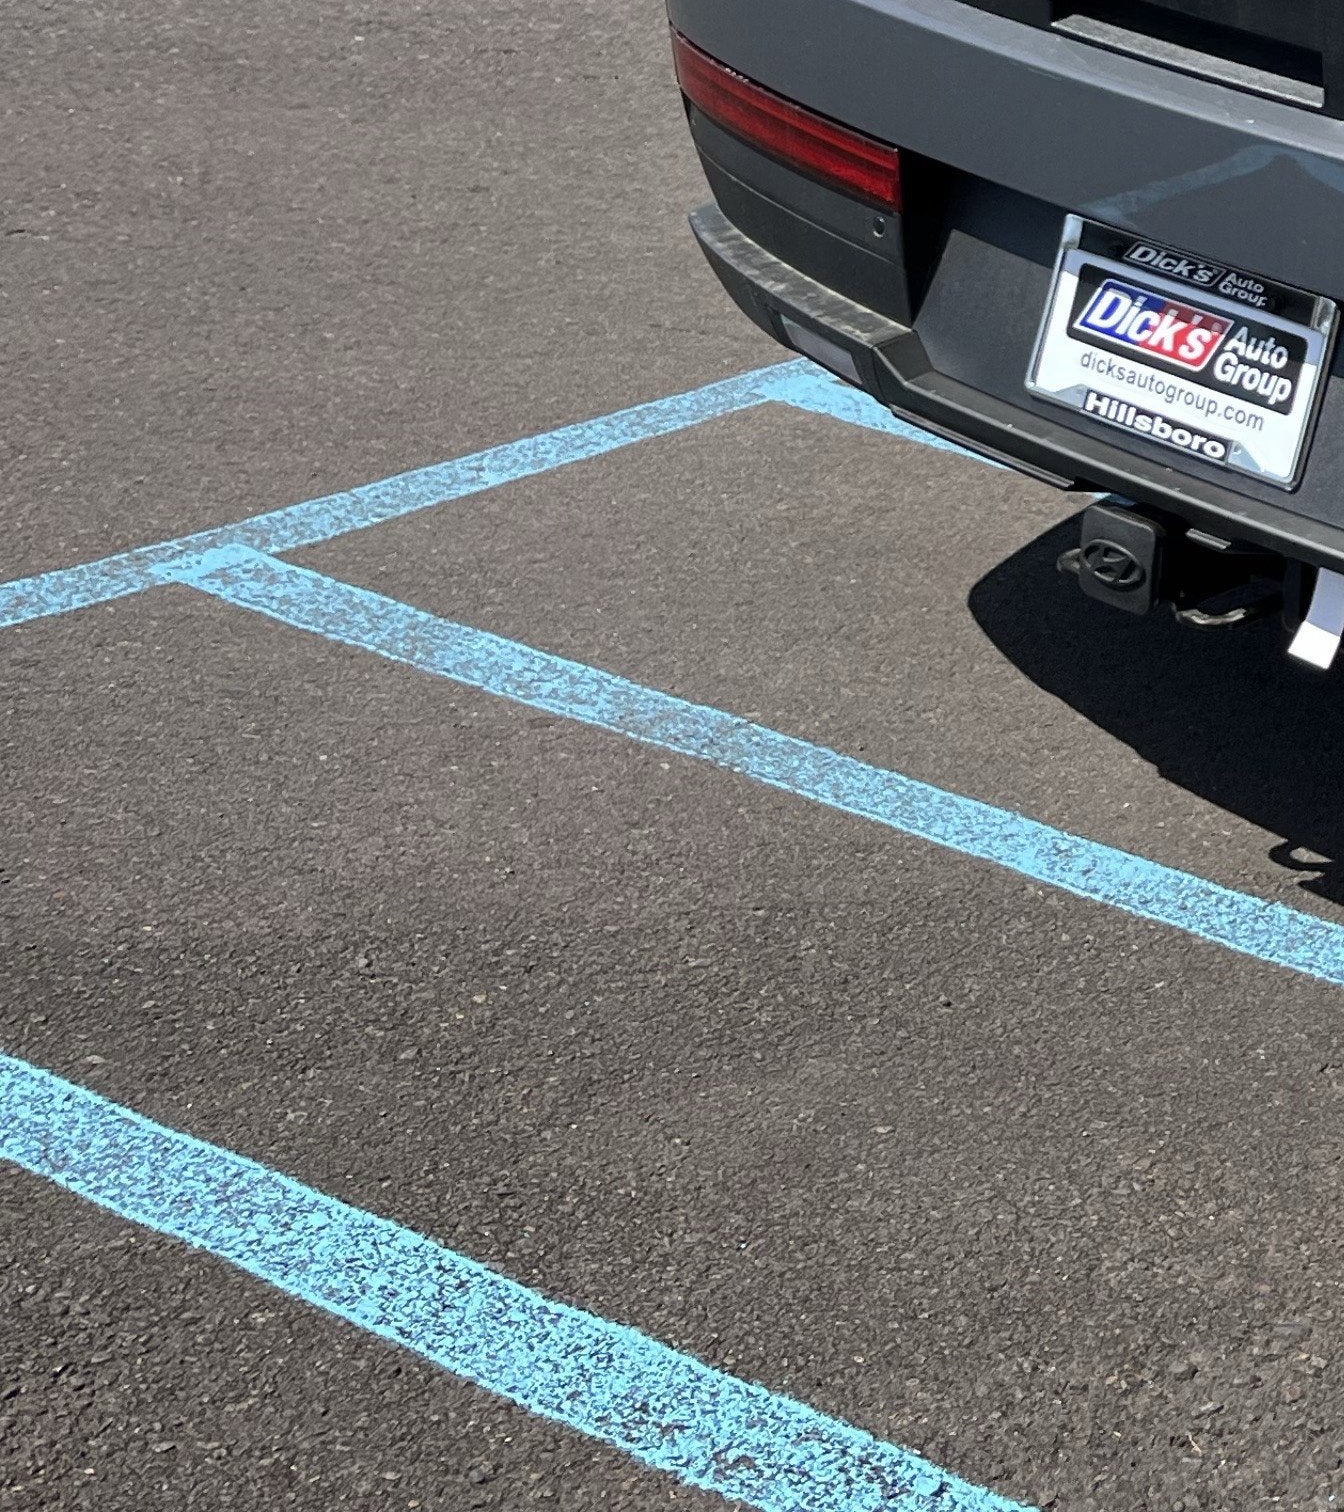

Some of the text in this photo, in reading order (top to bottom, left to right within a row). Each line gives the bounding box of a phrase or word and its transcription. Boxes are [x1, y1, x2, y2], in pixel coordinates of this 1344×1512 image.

[1129, 245, 1215, 284] Dick's
[1225, 272, 1265, 293] Auto
[1086, 288, 1216, 360] Dick's
[1222, 326, 1289, 370] Auto
[1080, 349, 1265, 432] dicksautogroup.com
[1213, 351, 1293, 405] Group
[1084, 391, 1226, 459] Hillsboro
